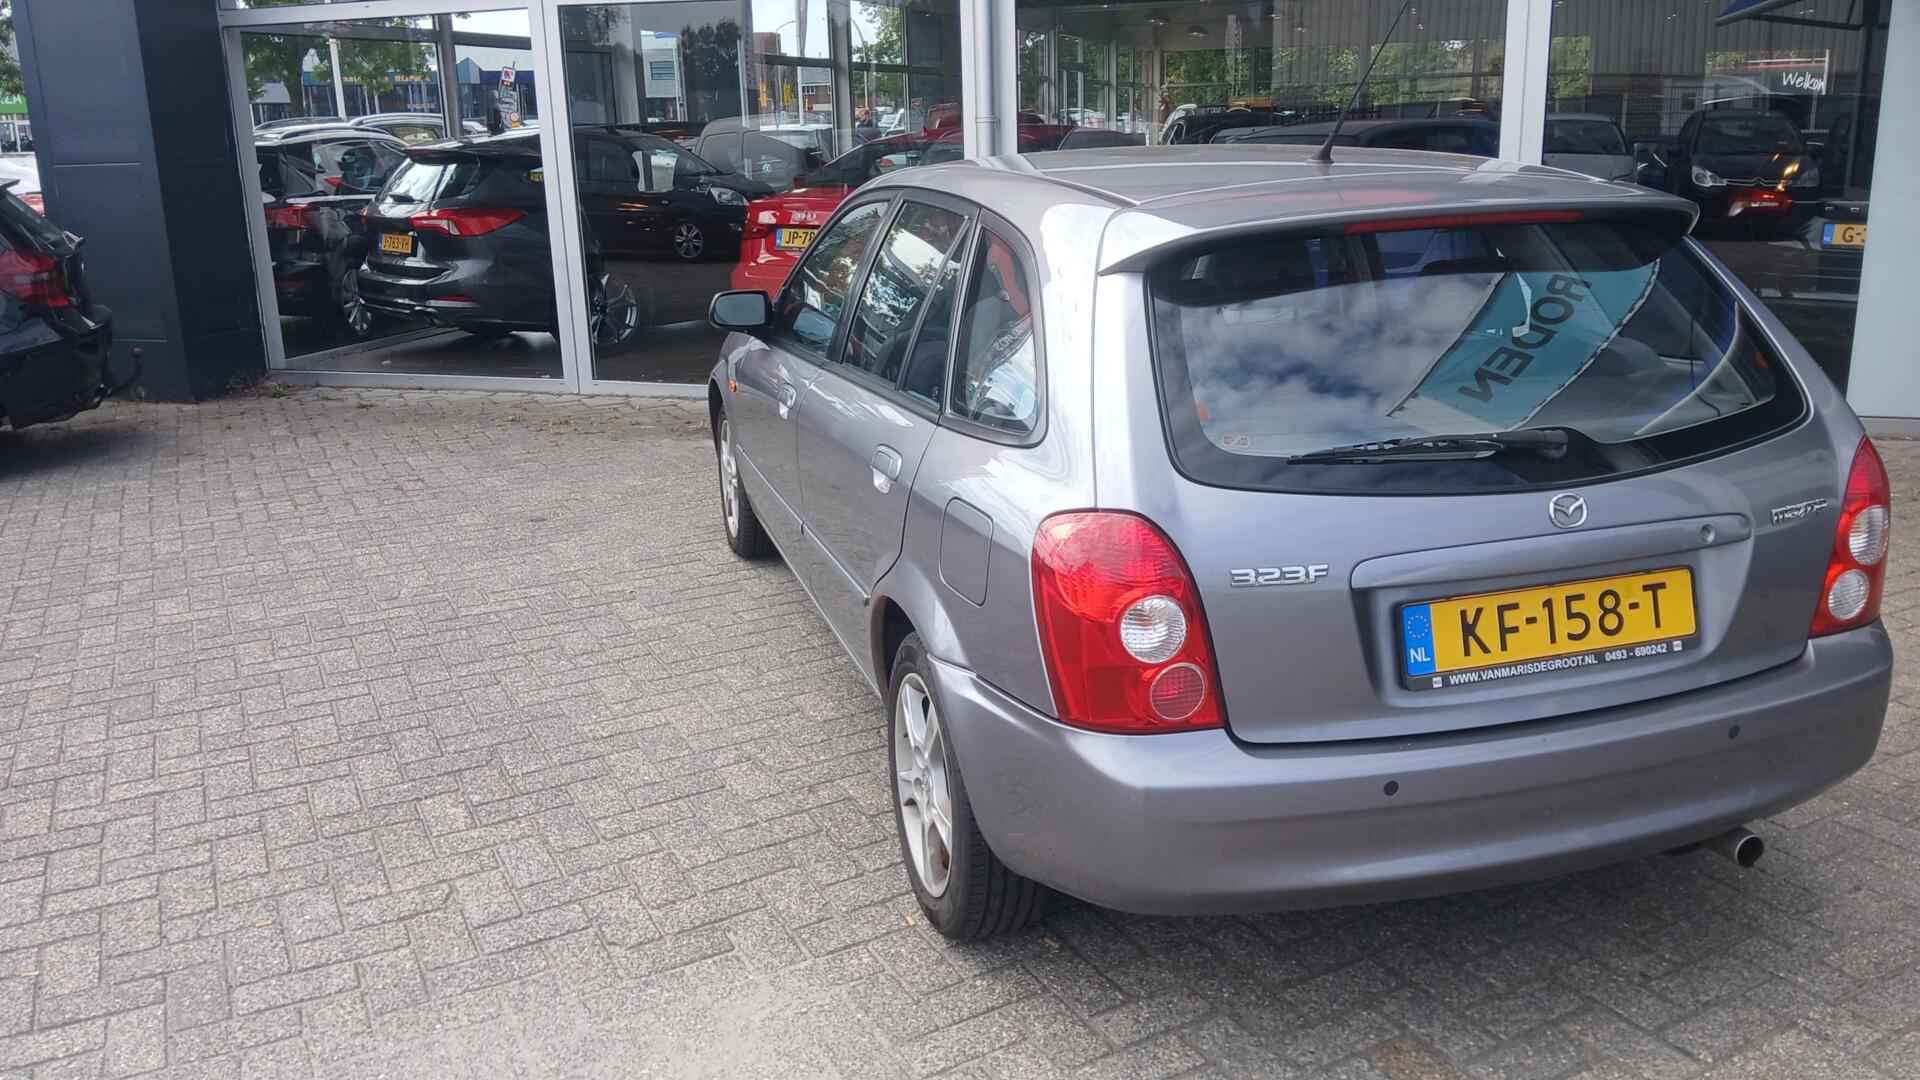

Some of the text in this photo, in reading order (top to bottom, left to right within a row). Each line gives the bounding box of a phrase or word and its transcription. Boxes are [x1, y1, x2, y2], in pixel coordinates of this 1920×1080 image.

[1230, 564, 1329, 588] 323F
[1459, 582, 1667, 657] KF-158-T
[1410, 647, 1431, 663] NL
[1449, 654, 1599, 686] WWW.VANMARISDEGROOT.NL
[1605, 649, 1628, 662] 0493
[1634, 643, 1668, 657] 690242
